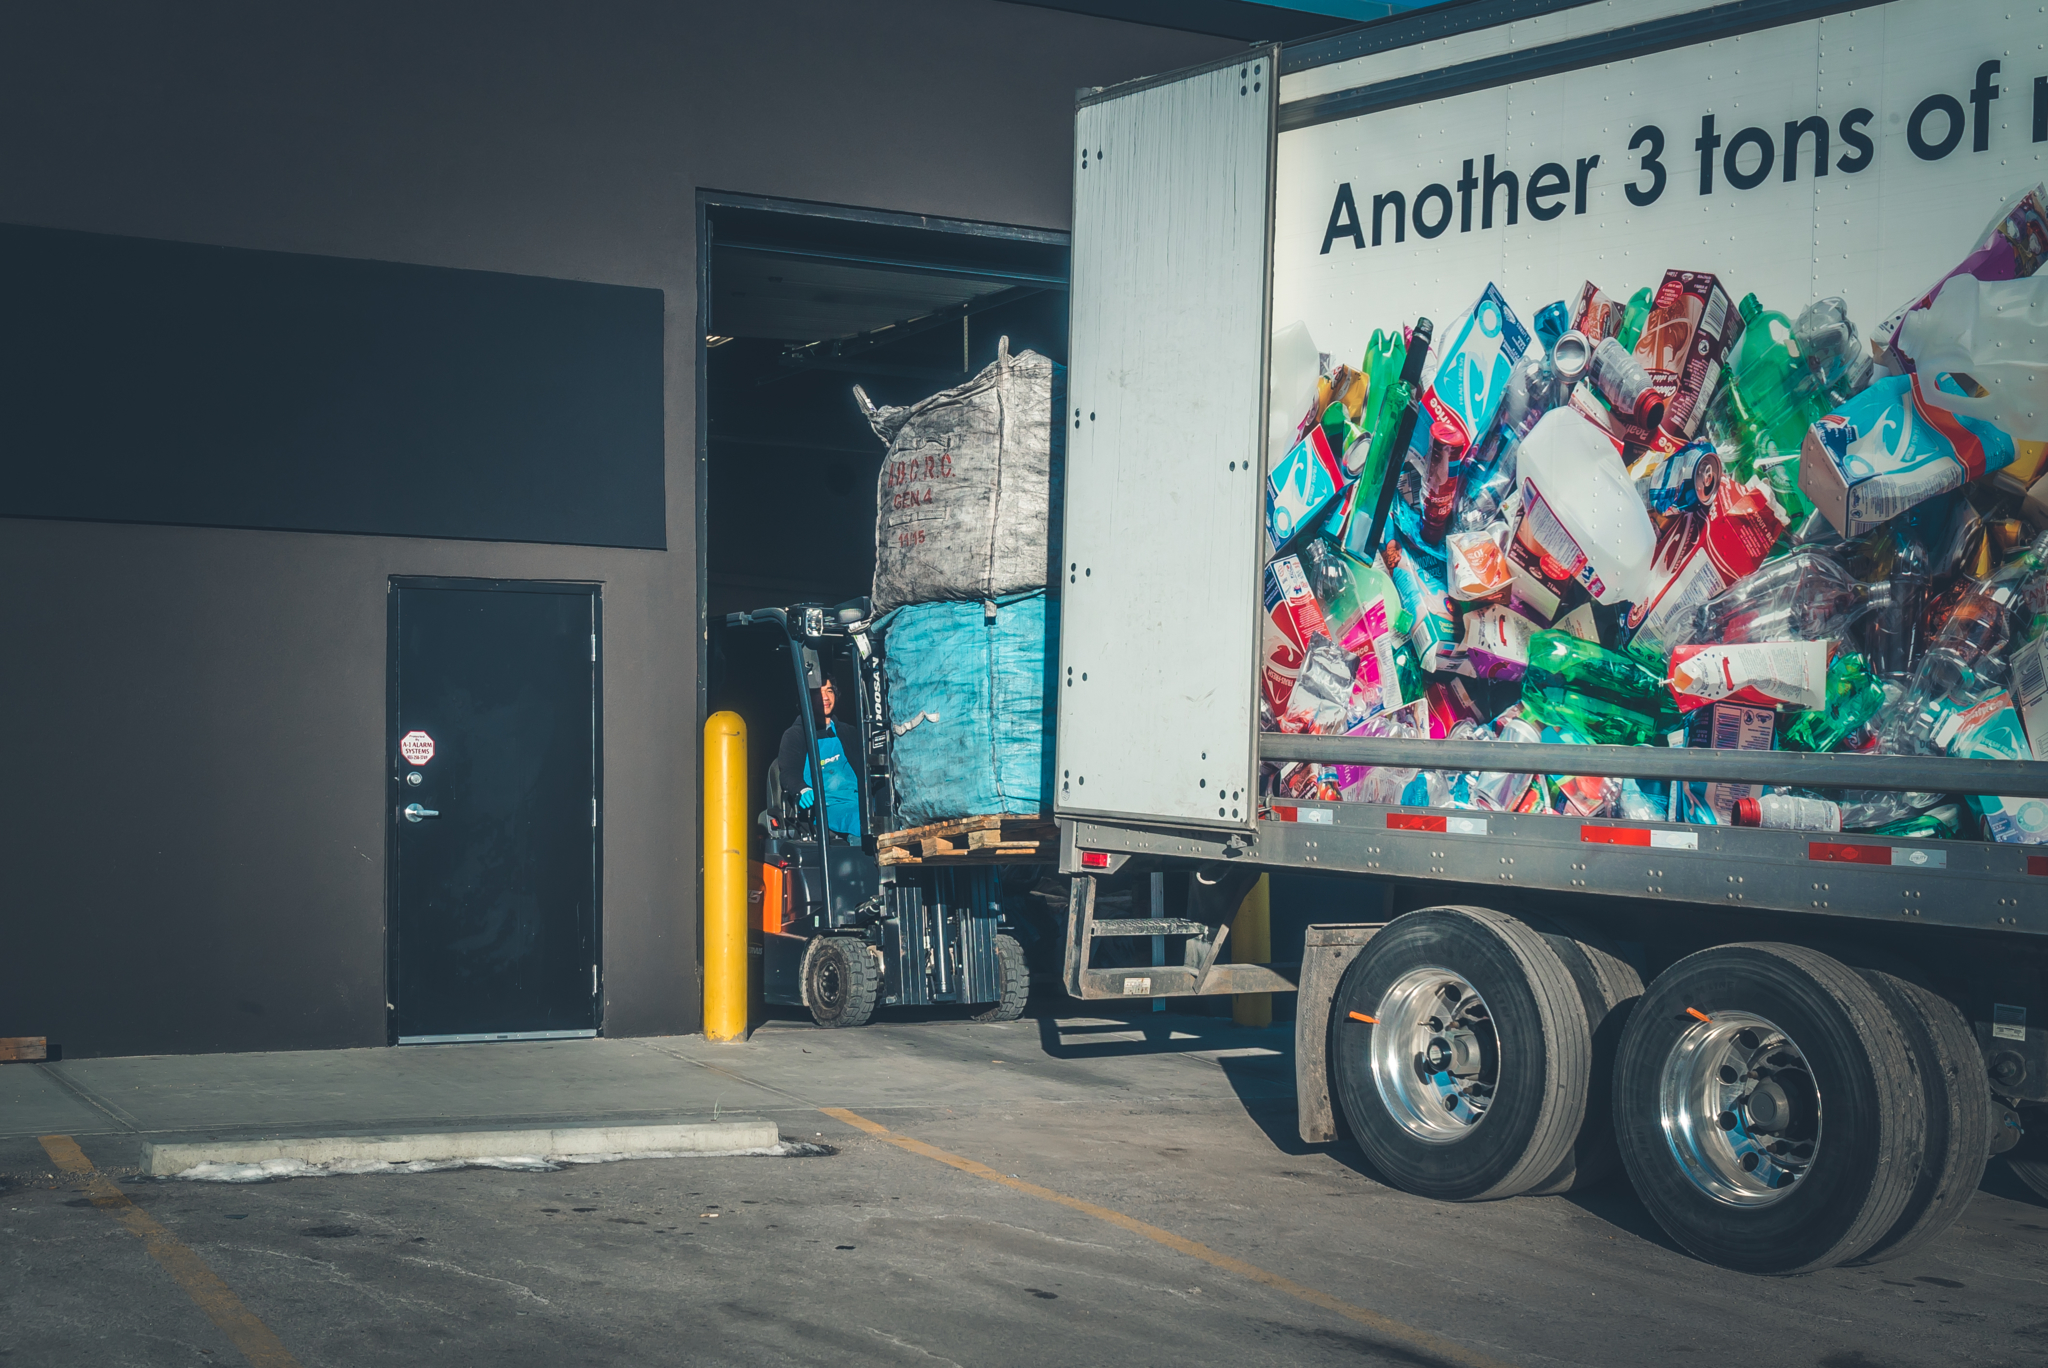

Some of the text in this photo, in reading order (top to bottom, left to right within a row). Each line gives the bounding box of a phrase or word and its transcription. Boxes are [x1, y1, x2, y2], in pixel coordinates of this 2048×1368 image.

[1319, 153, 1600, 255] Another
[1624, 124, 1667, 207] 3
[1694, 107, 1875, 196] tons
[1906, 59, 2001, 161] of
[893, 487, 933, 511] GEN 4
